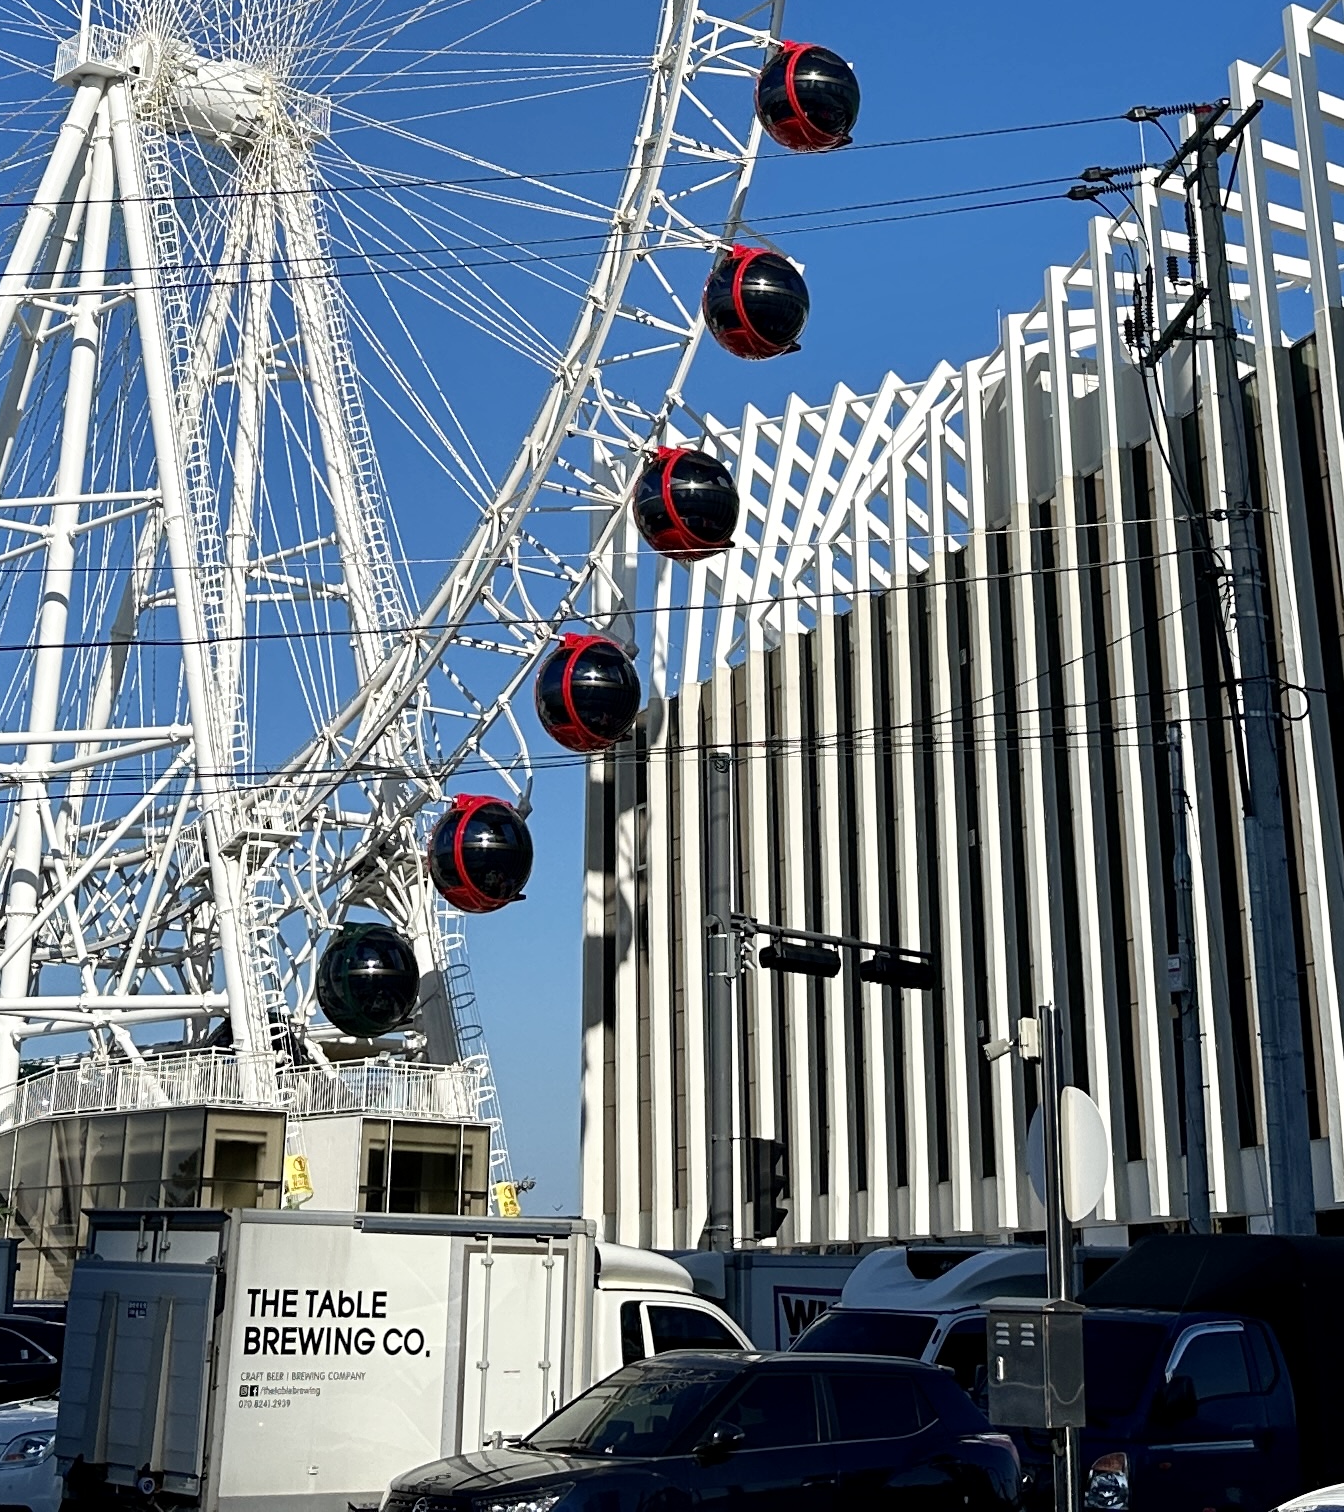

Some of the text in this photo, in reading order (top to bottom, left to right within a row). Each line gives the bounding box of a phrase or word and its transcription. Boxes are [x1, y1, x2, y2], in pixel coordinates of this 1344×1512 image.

[246, 1288, 388, 1319] THE TAbLE
[243, 1326, 431, 1358] BREWING CO.
[240, 1371, 367, 1382] CRAFT BEER BREWING COMPANY
